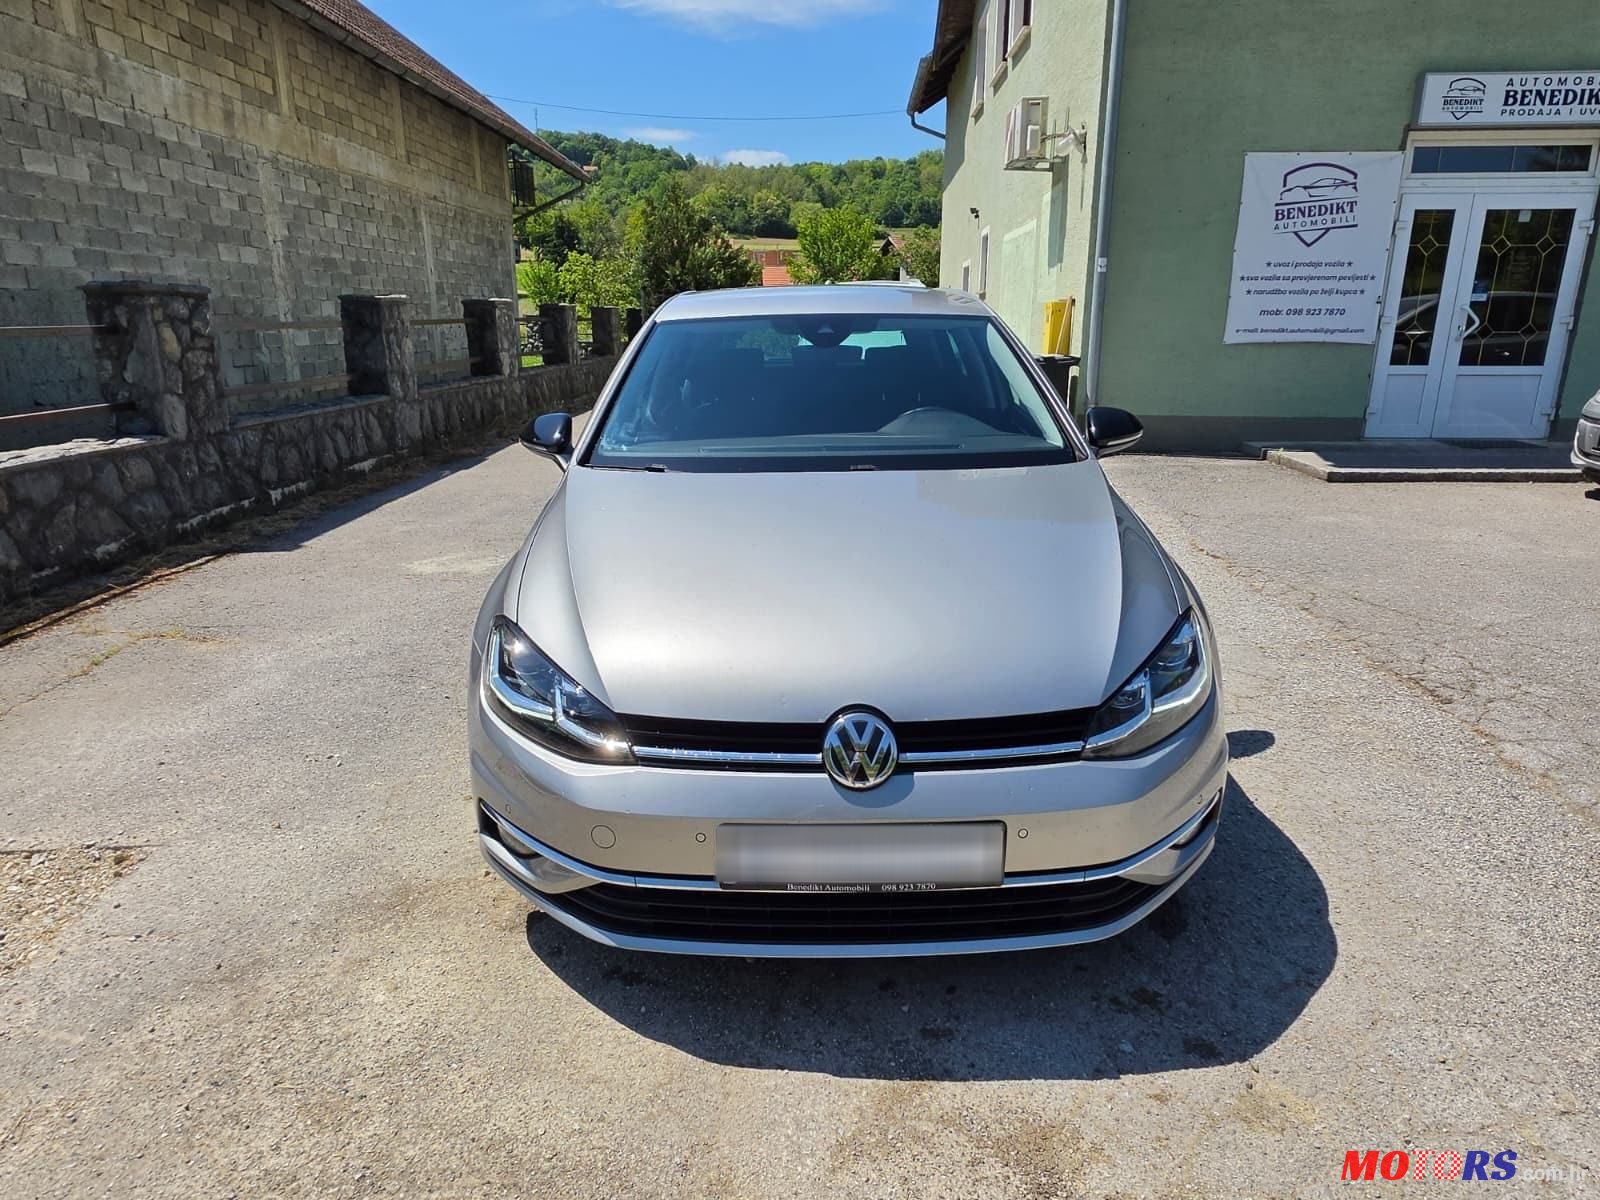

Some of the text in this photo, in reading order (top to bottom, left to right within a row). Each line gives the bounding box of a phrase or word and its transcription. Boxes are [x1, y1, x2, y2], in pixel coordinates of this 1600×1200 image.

[1505, 76, 1600, 87] AUTOMOB
[1443, 98, 1485, 106] BENEDIKT
[1501, 107, 1600, 116] PRODAJA I UV
[1274, 201, 1357, 222] BENEDIKT
[1273, 216, 1356, 231] AUTOMOBILI
[1294, 260, 1323, 270] prodaja
[1324, 260, 1345, 268] vozila
[1260, 273, 1280, 281] vozila
[1291, 273, 1337, 283] provjerenom
[1338, 272, 1369, 283] povijesti
[1288, 286, 1308, 295] vozila
[1309, 289, 1320, 297] po
[1320, 286, 1335, 297] želji
[1335, 286, 1358, 297] kupca
[1259, 308, 1346, 316] mob: 098 923 7870
[787, 882, 936, 892] Benedikt Automobili 098 923 7870
